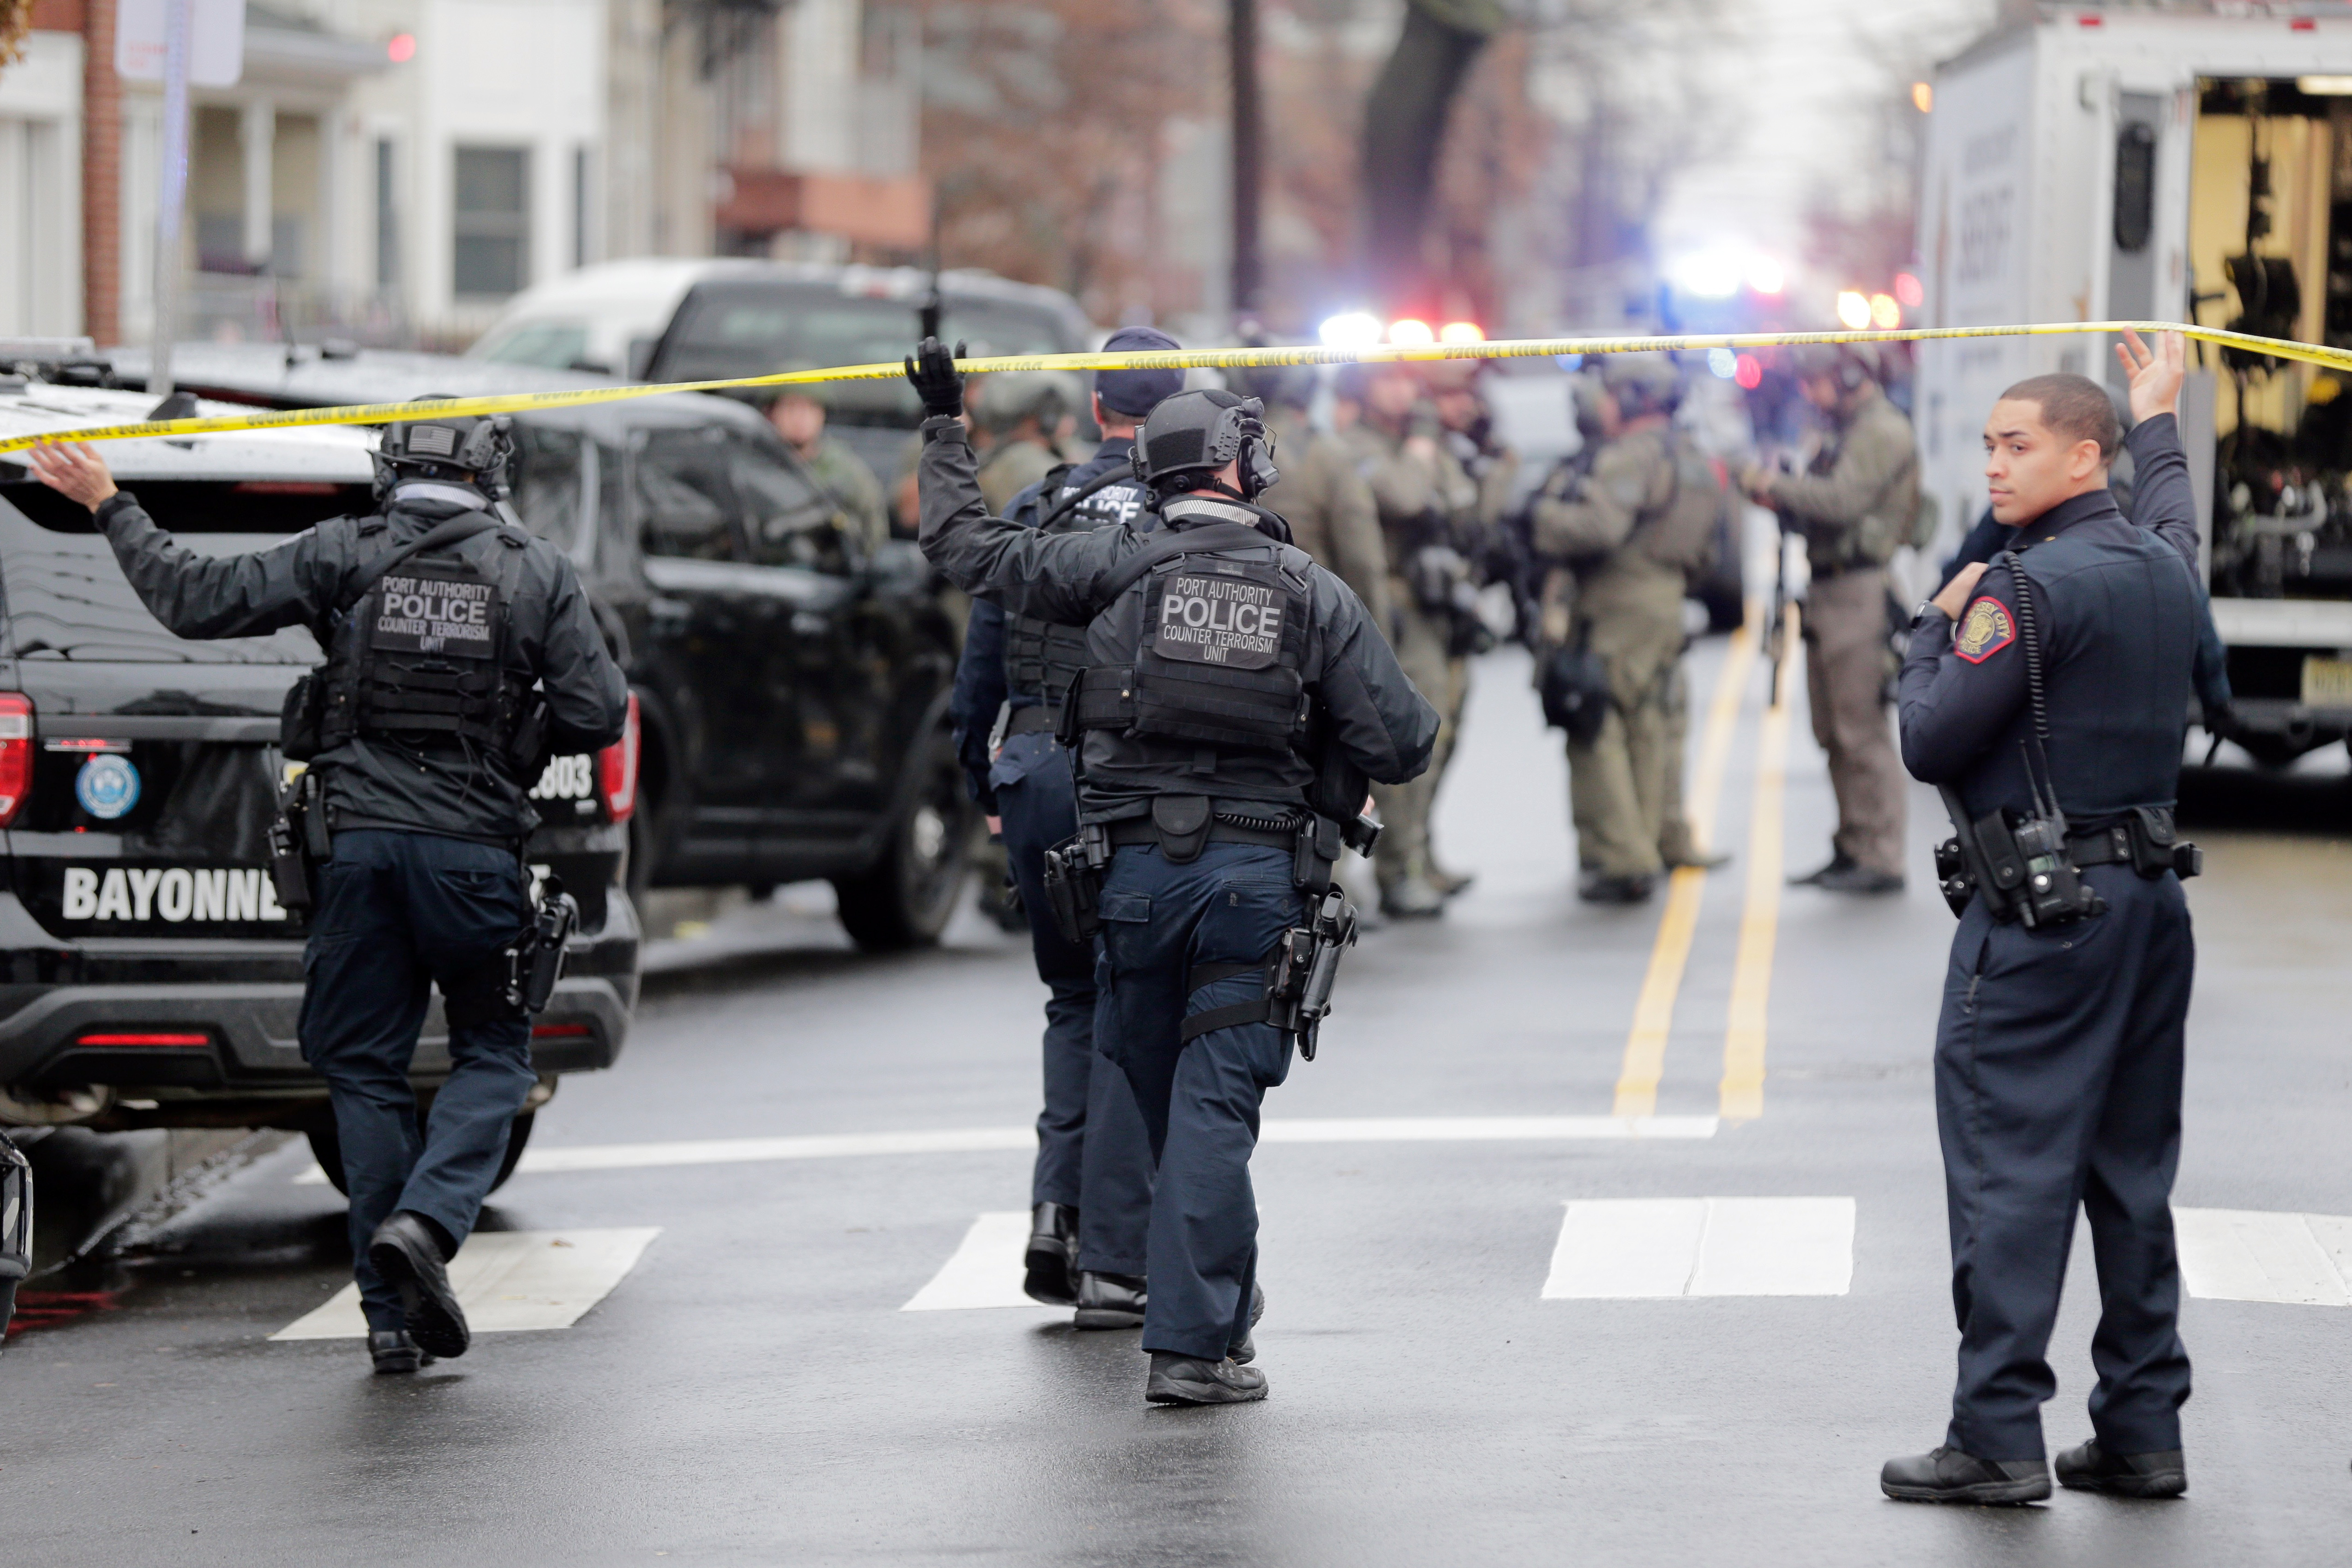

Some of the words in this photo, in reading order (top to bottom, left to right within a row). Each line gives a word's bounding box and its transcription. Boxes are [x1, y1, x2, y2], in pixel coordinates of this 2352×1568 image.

[382, 576, 417, 594] PORT
[419, 580, 492, 601] AUTHORITY
[1176, 577, 1207, 597] PORT
[1208, 581, 1273, 606] AUTHORITY
[384, 593, 487, 624] POLICE
[1162, 595, 1281, 638] POLICE
[378, 616, 427, 636] COUNTER
[431, 621, 490, 641] TERRORISM
[1994, 613, 2010, 638] CITY
[420, 636, 445, 652] UNIT
[1164, 625, 1212, 645] COUNTER
[1215, 631, 1273, 654] TERRORISM
[1204, 645, 1229, 663] UNIT
[529, 753, 592, 799] 803
